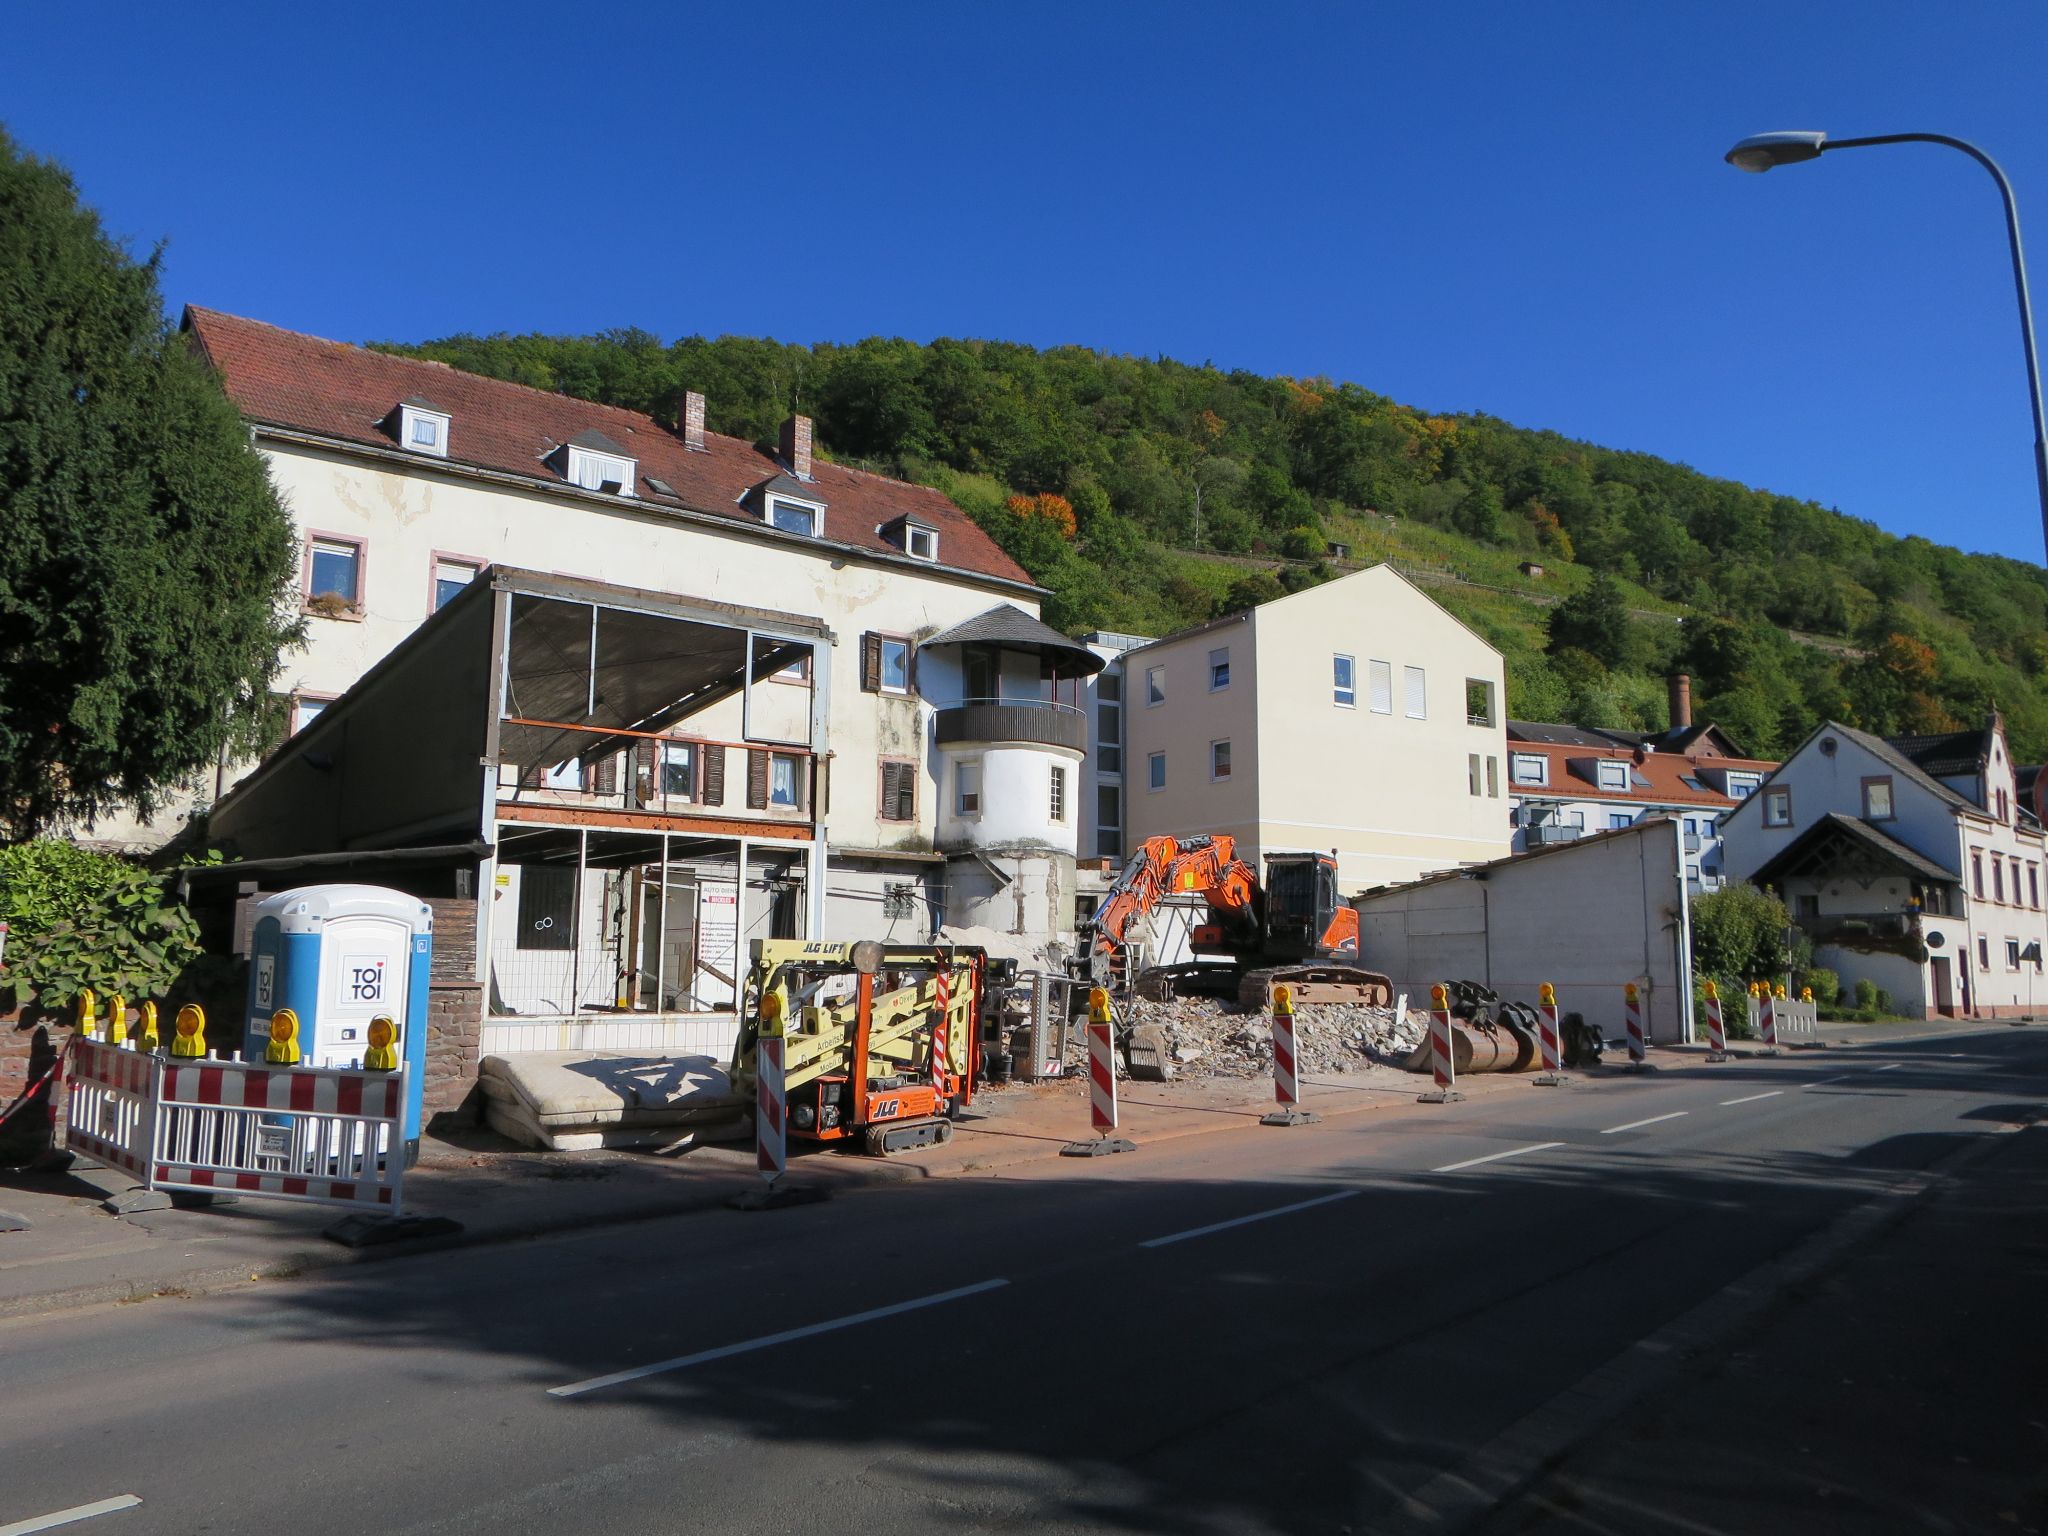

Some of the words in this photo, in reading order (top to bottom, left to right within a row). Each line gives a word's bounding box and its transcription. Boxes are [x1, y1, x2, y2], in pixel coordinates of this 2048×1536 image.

[803, 943, 821, 953] JLG
[823, 944, 844, 954] LIFT
[352, 968, 382, 983] TOI
[352, 984, 381, 1000] TOI
[873, 1099, 899, 1119] JLG
